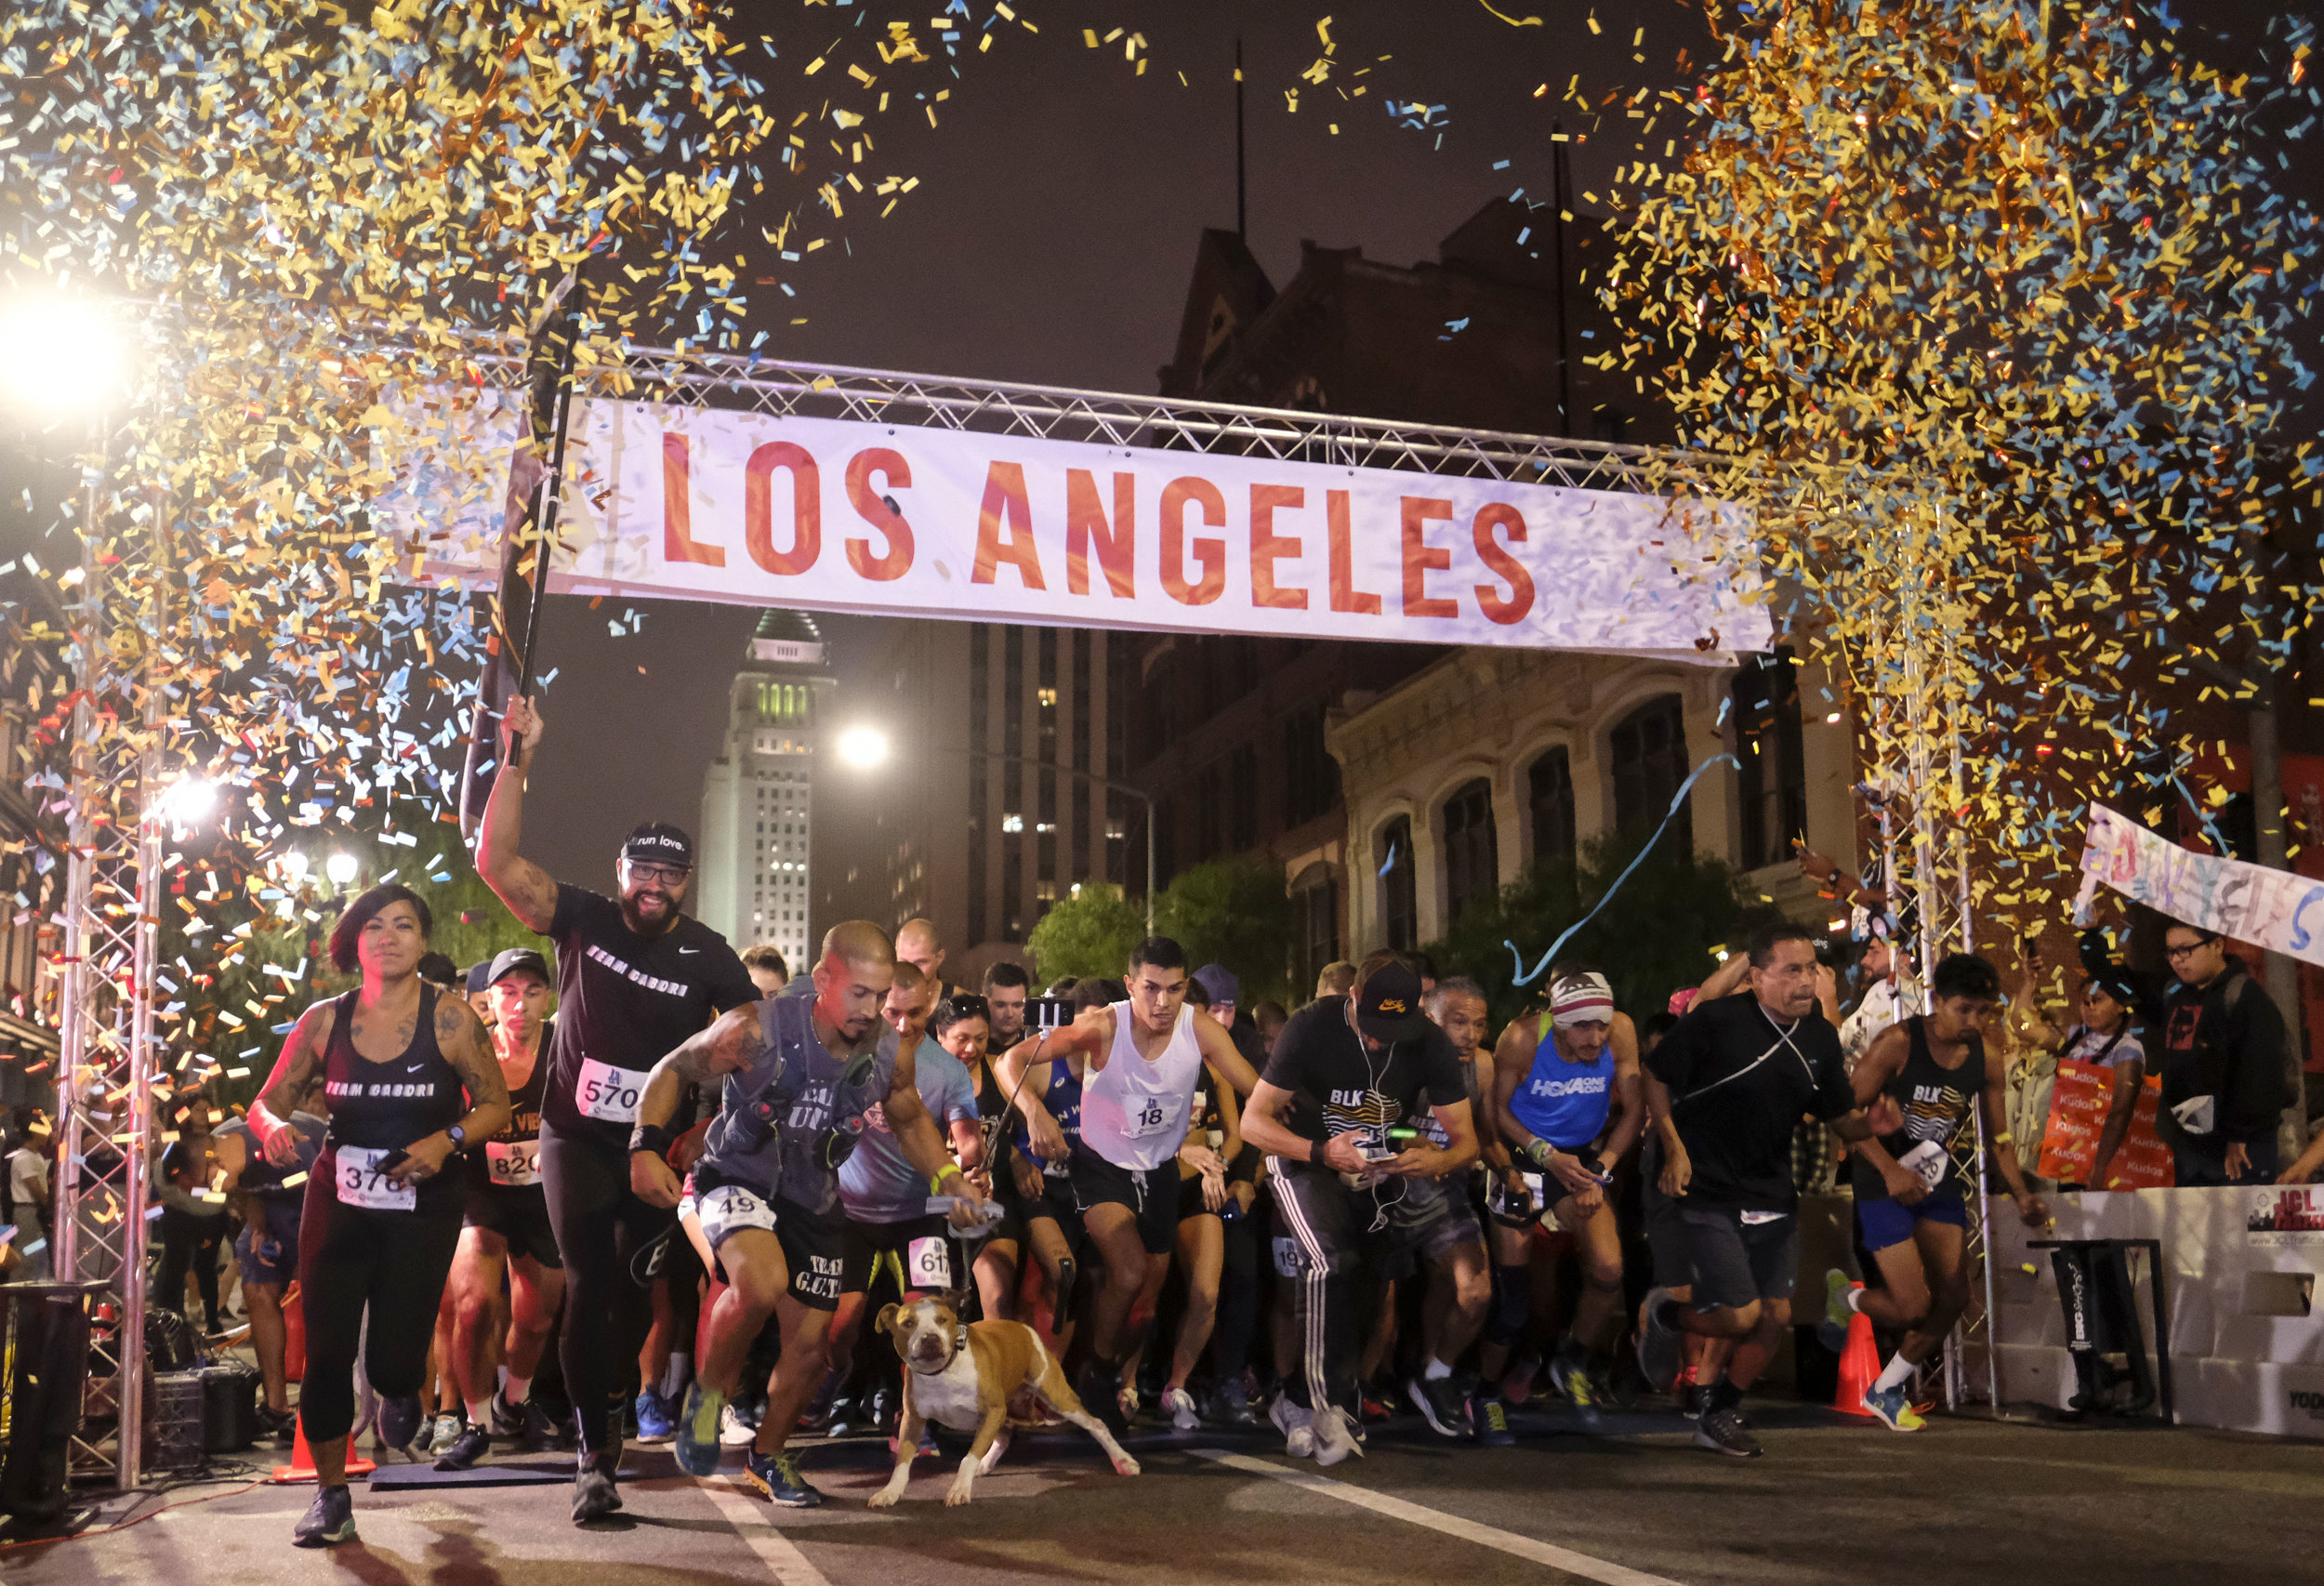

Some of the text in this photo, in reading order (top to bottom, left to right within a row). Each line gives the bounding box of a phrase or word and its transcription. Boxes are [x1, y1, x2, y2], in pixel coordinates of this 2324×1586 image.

[662, 431, 1536, 626] LOS ANGELES
[638, 835, 685, 852] run love.
[586, 945, 629, 975] TEAM
[325, 1080, 363, 1097] TEAM
[585, 1079, 639, 1109] 570
[1913, 1084, 1942, 1104] BLK
[1329, 1089, 1365, 1107] BLK
[2059, 1093, 2094, 1111] Kudos
[1138, 1108, 1163, 1127] 18
[2130, 1135, 2166, 1151] Kudos
[2127, 1160, 2164, 1176] Kudos
[719, 1196, 755, 1214] 49
[2273, 1189, 2317, 1213] JCL
